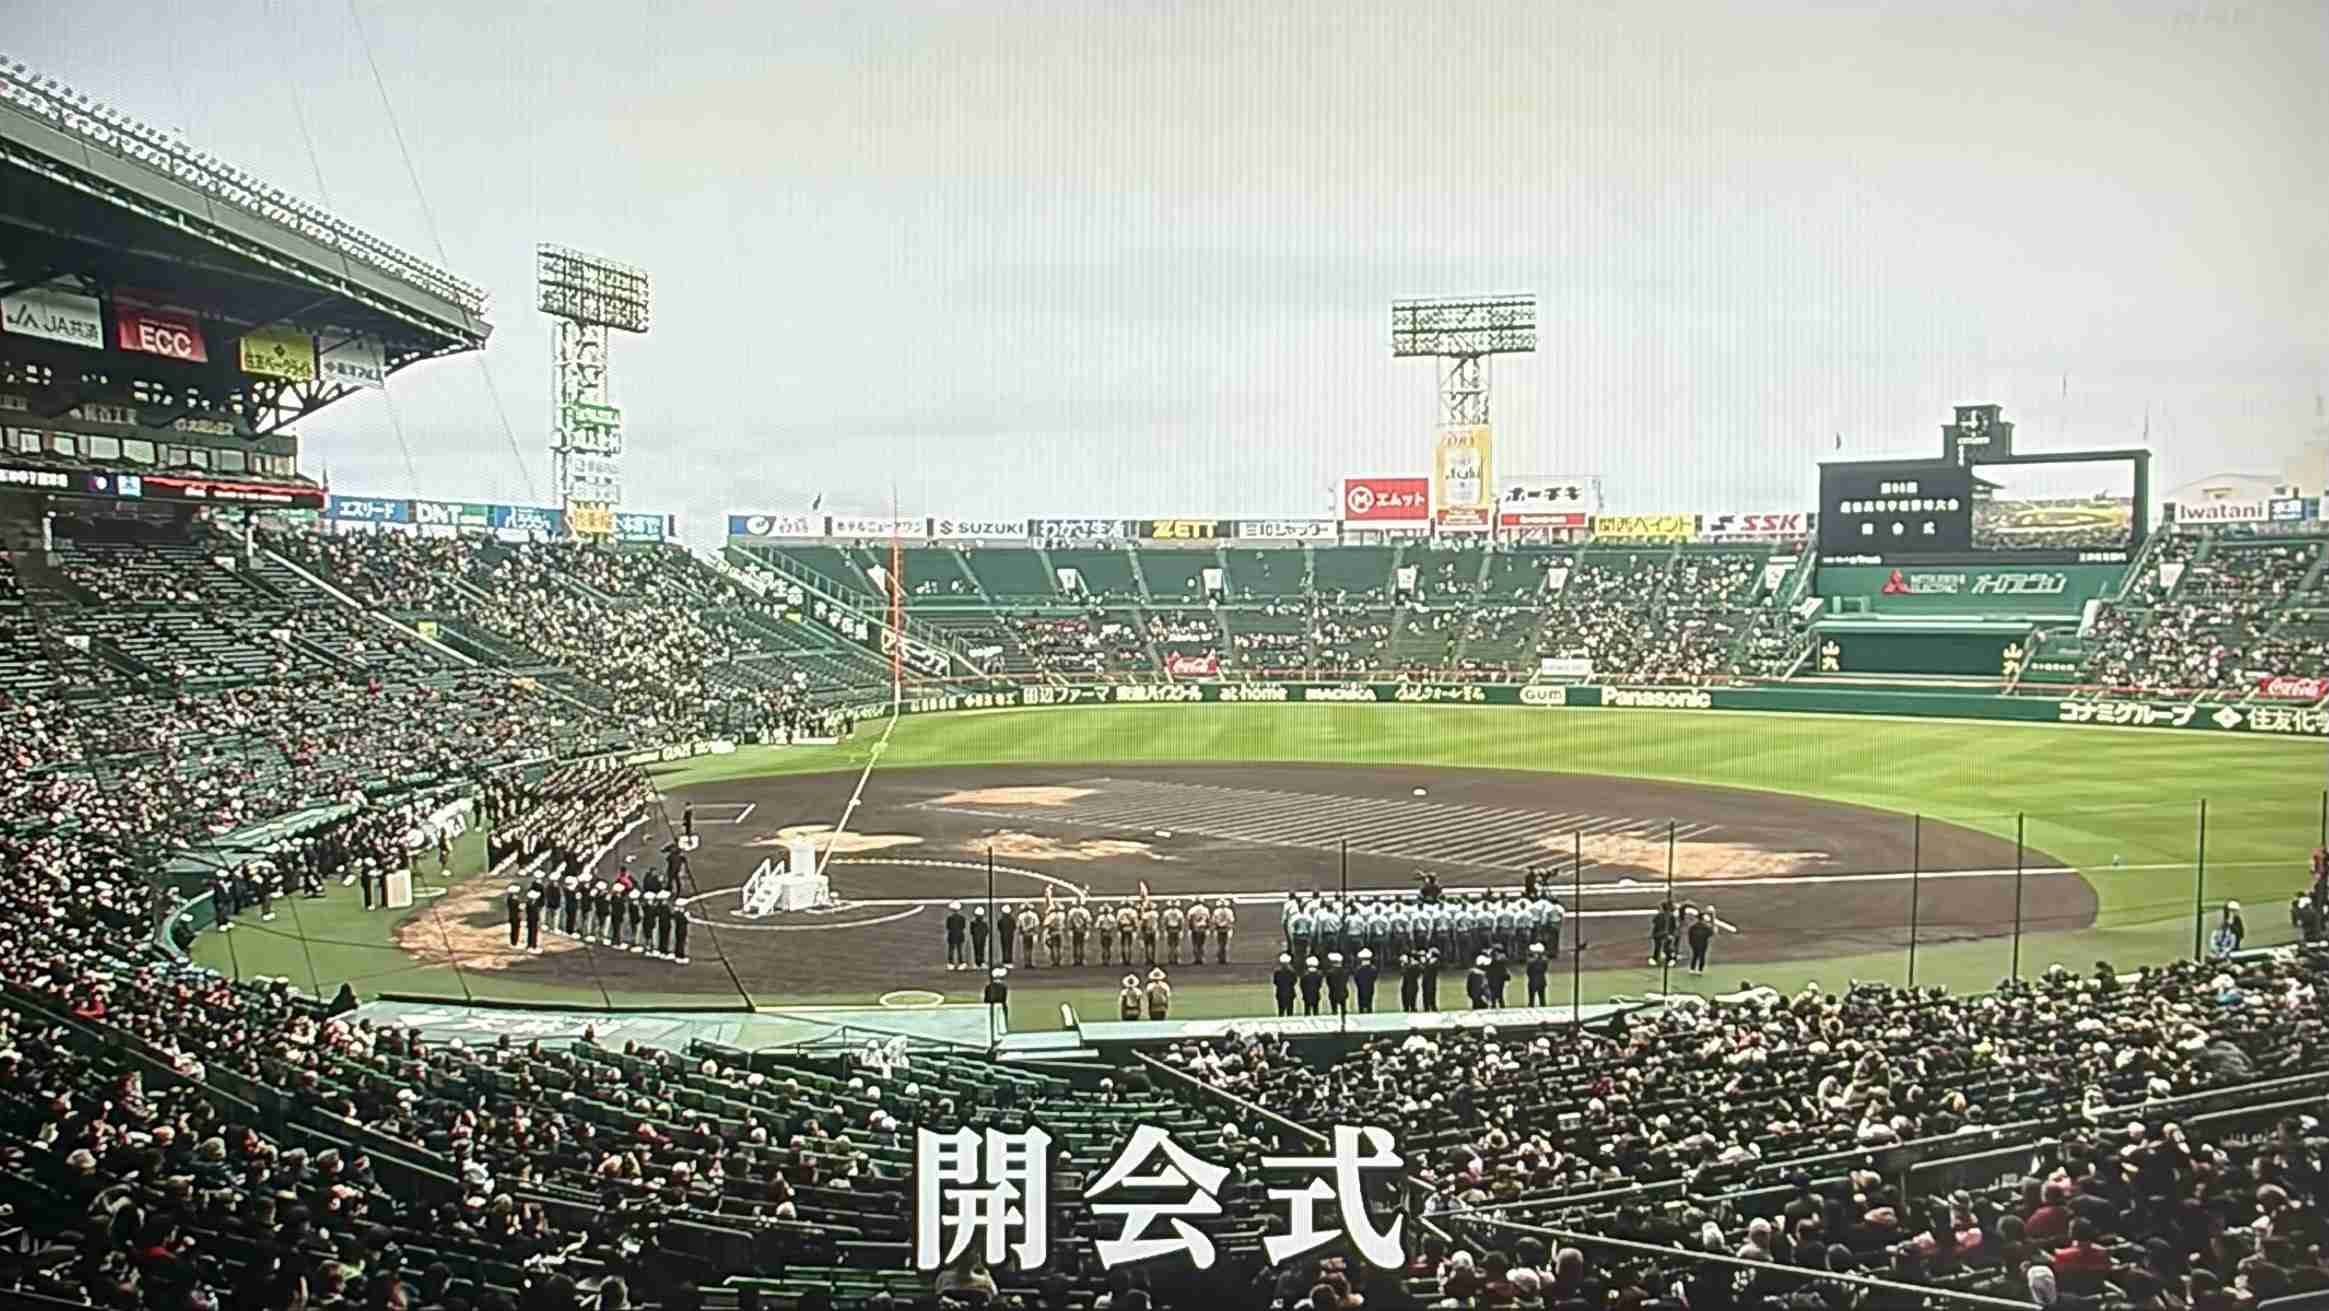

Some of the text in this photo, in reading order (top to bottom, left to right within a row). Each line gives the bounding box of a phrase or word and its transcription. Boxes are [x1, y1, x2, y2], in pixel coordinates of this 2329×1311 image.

[140, 323, 192, 356] ECC
[1375, 492, 1424, 508] エムット
[1505, 486, 1582, 501] ホーチキ
[339, 501, 395, 518] エスリード
[416, 502, 463, 524] DNT
[2180, 502, 2263, 519] Iwatani
[958, 521, 1023, 534] SUZUKI
[1152, 520, 1217, 538] ZETT
[1600, 517, 1692, 533] 関西ペイント
[1741, 514, 1800, 531] SSK
[1023, 685, 1110, 704] 田辺ファーマ
[1219, 686, 1237, 700] at
[1239, 684, 1288, 700] home
[1601, 686, 1712, 708] Panasonic
[2059, 702, 2196, 726] コナミグループ
